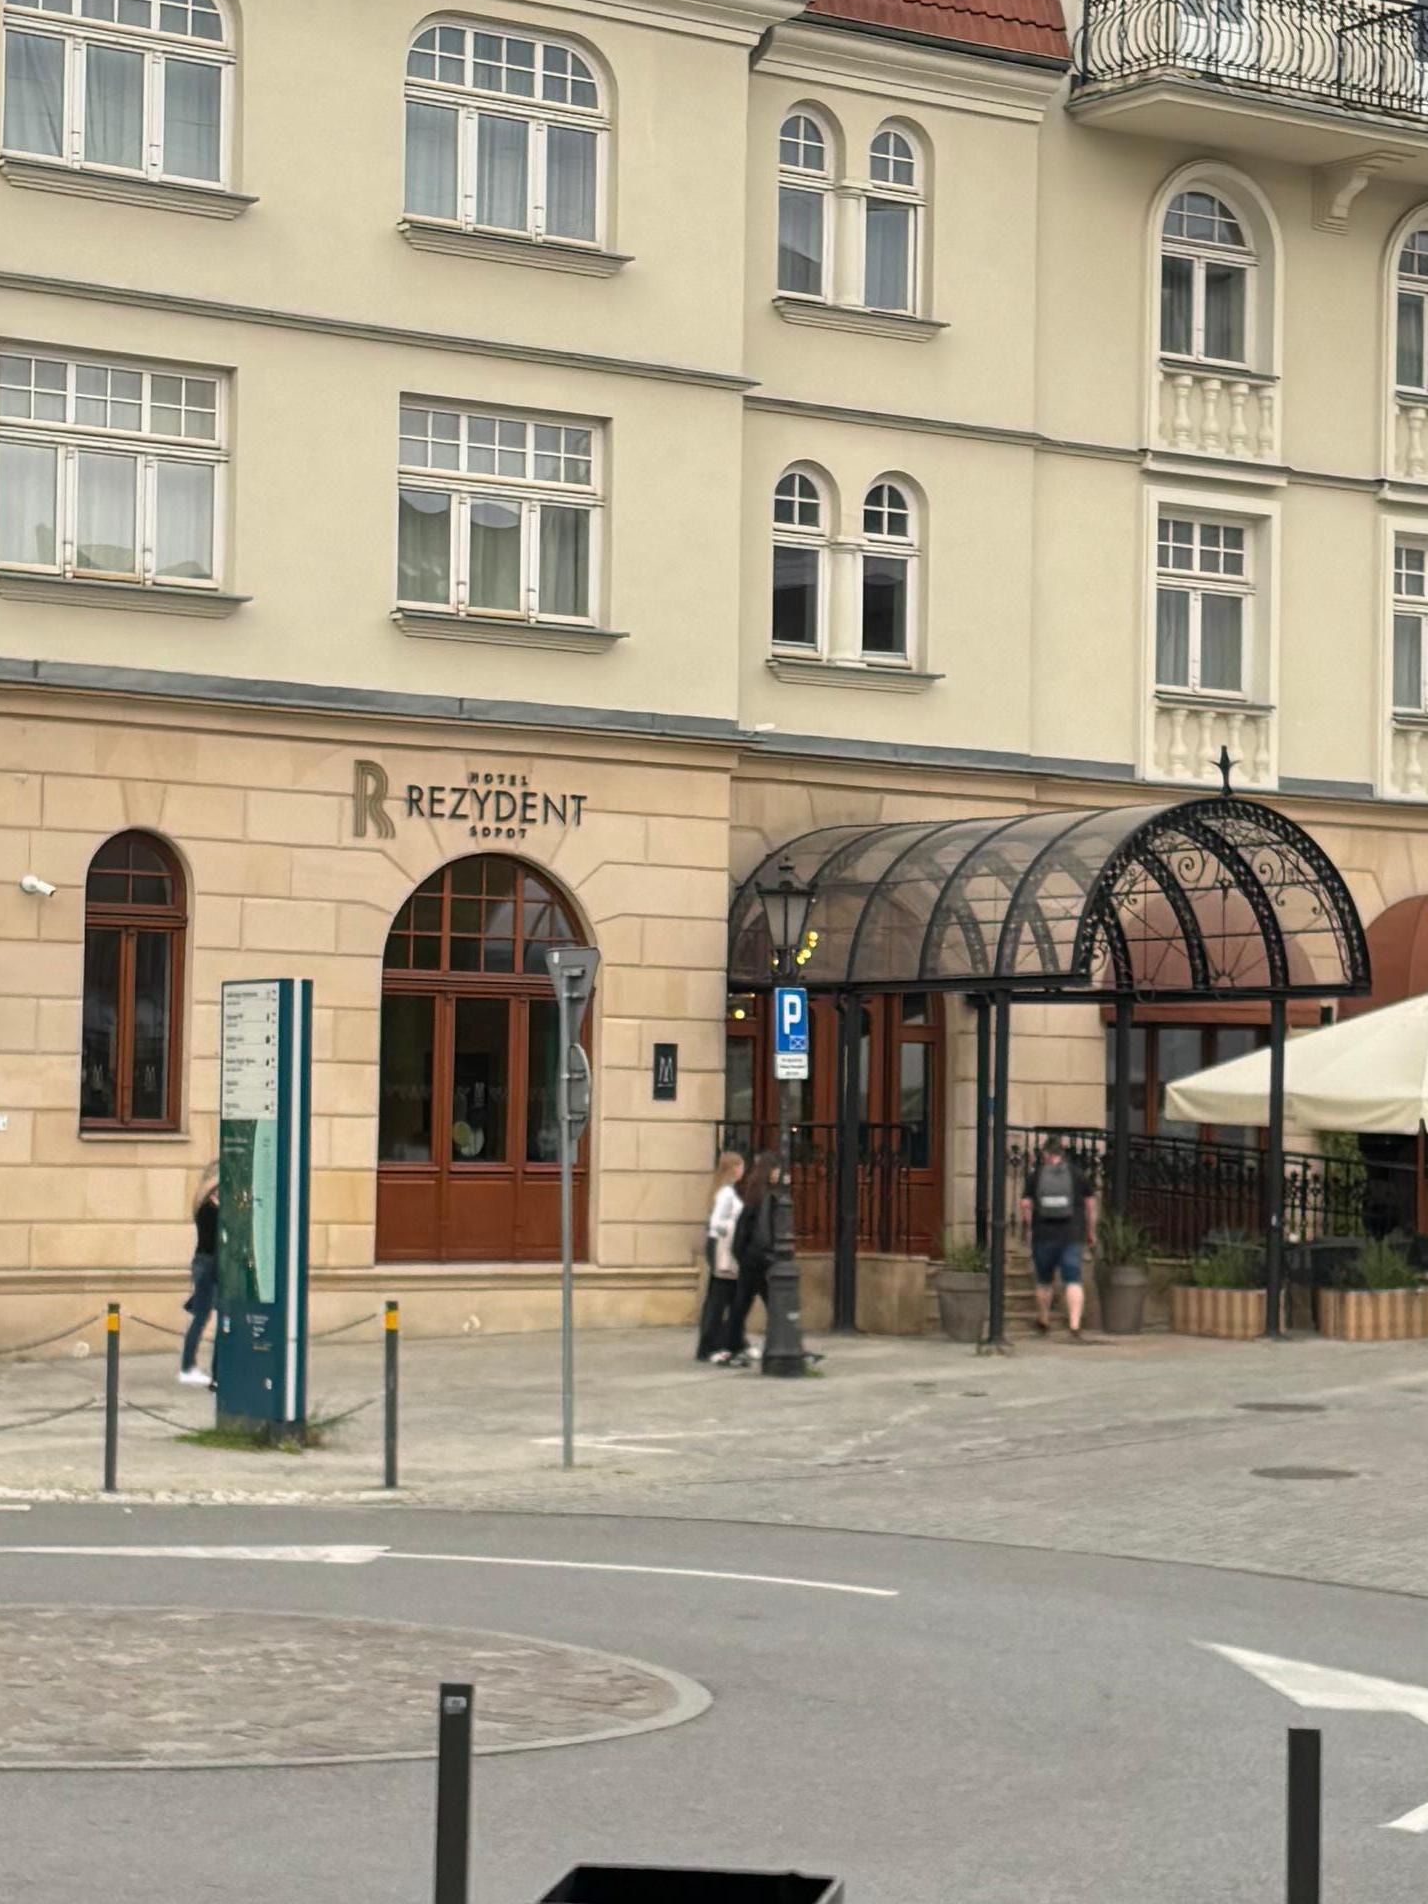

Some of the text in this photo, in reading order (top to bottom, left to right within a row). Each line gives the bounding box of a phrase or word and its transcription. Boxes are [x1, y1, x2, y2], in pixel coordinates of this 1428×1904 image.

[468, 772, 529, 786] HOTEL
[406, 784, 588, 827] REZYDENT
[469, 825, 528, 840] SOPOT
[783, 994, 802, 1035] P
